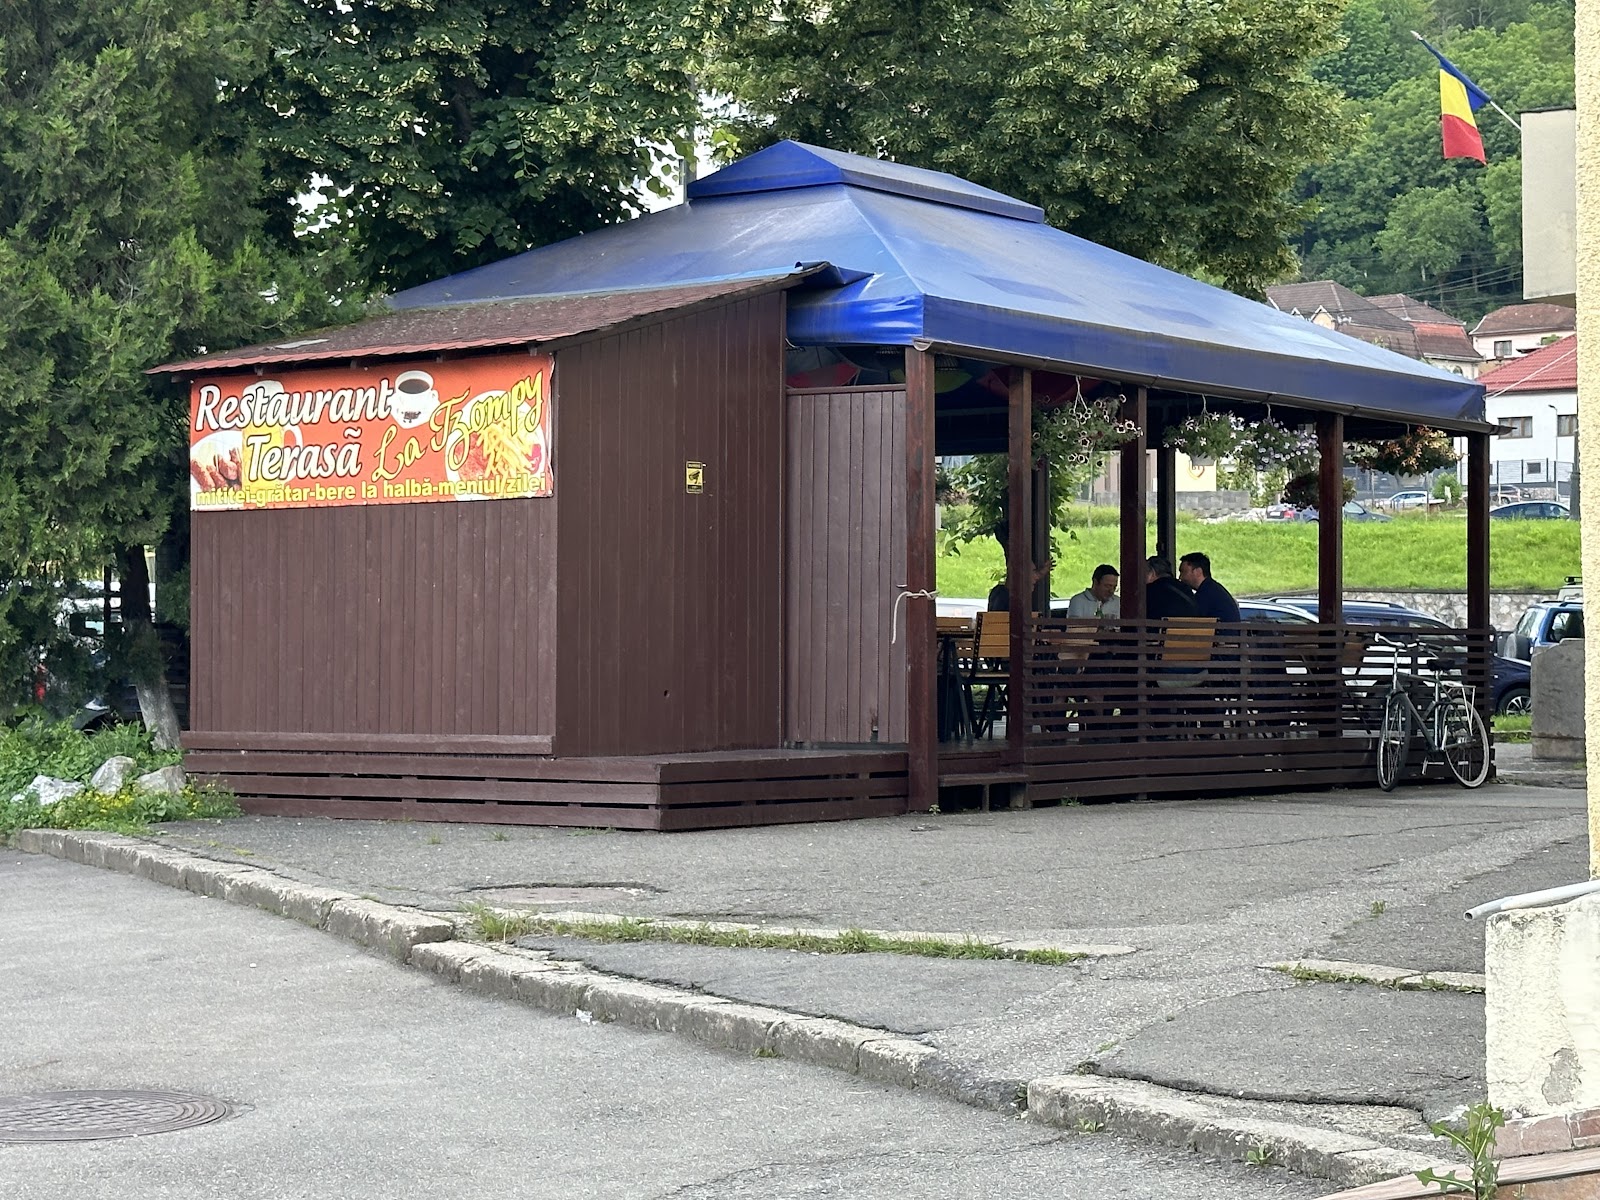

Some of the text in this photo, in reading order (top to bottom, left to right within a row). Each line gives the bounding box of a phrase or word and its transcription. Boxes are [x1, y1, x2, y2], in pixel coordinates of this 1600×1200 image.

[194, 378, 394, 432] Restaurant
[371, 369, 544, 483] La Tzompy
[361, 480, 378, 499] la
[383, 473, 501, 498] halbă-meniul
[505, 472, 546, 493] zilei
